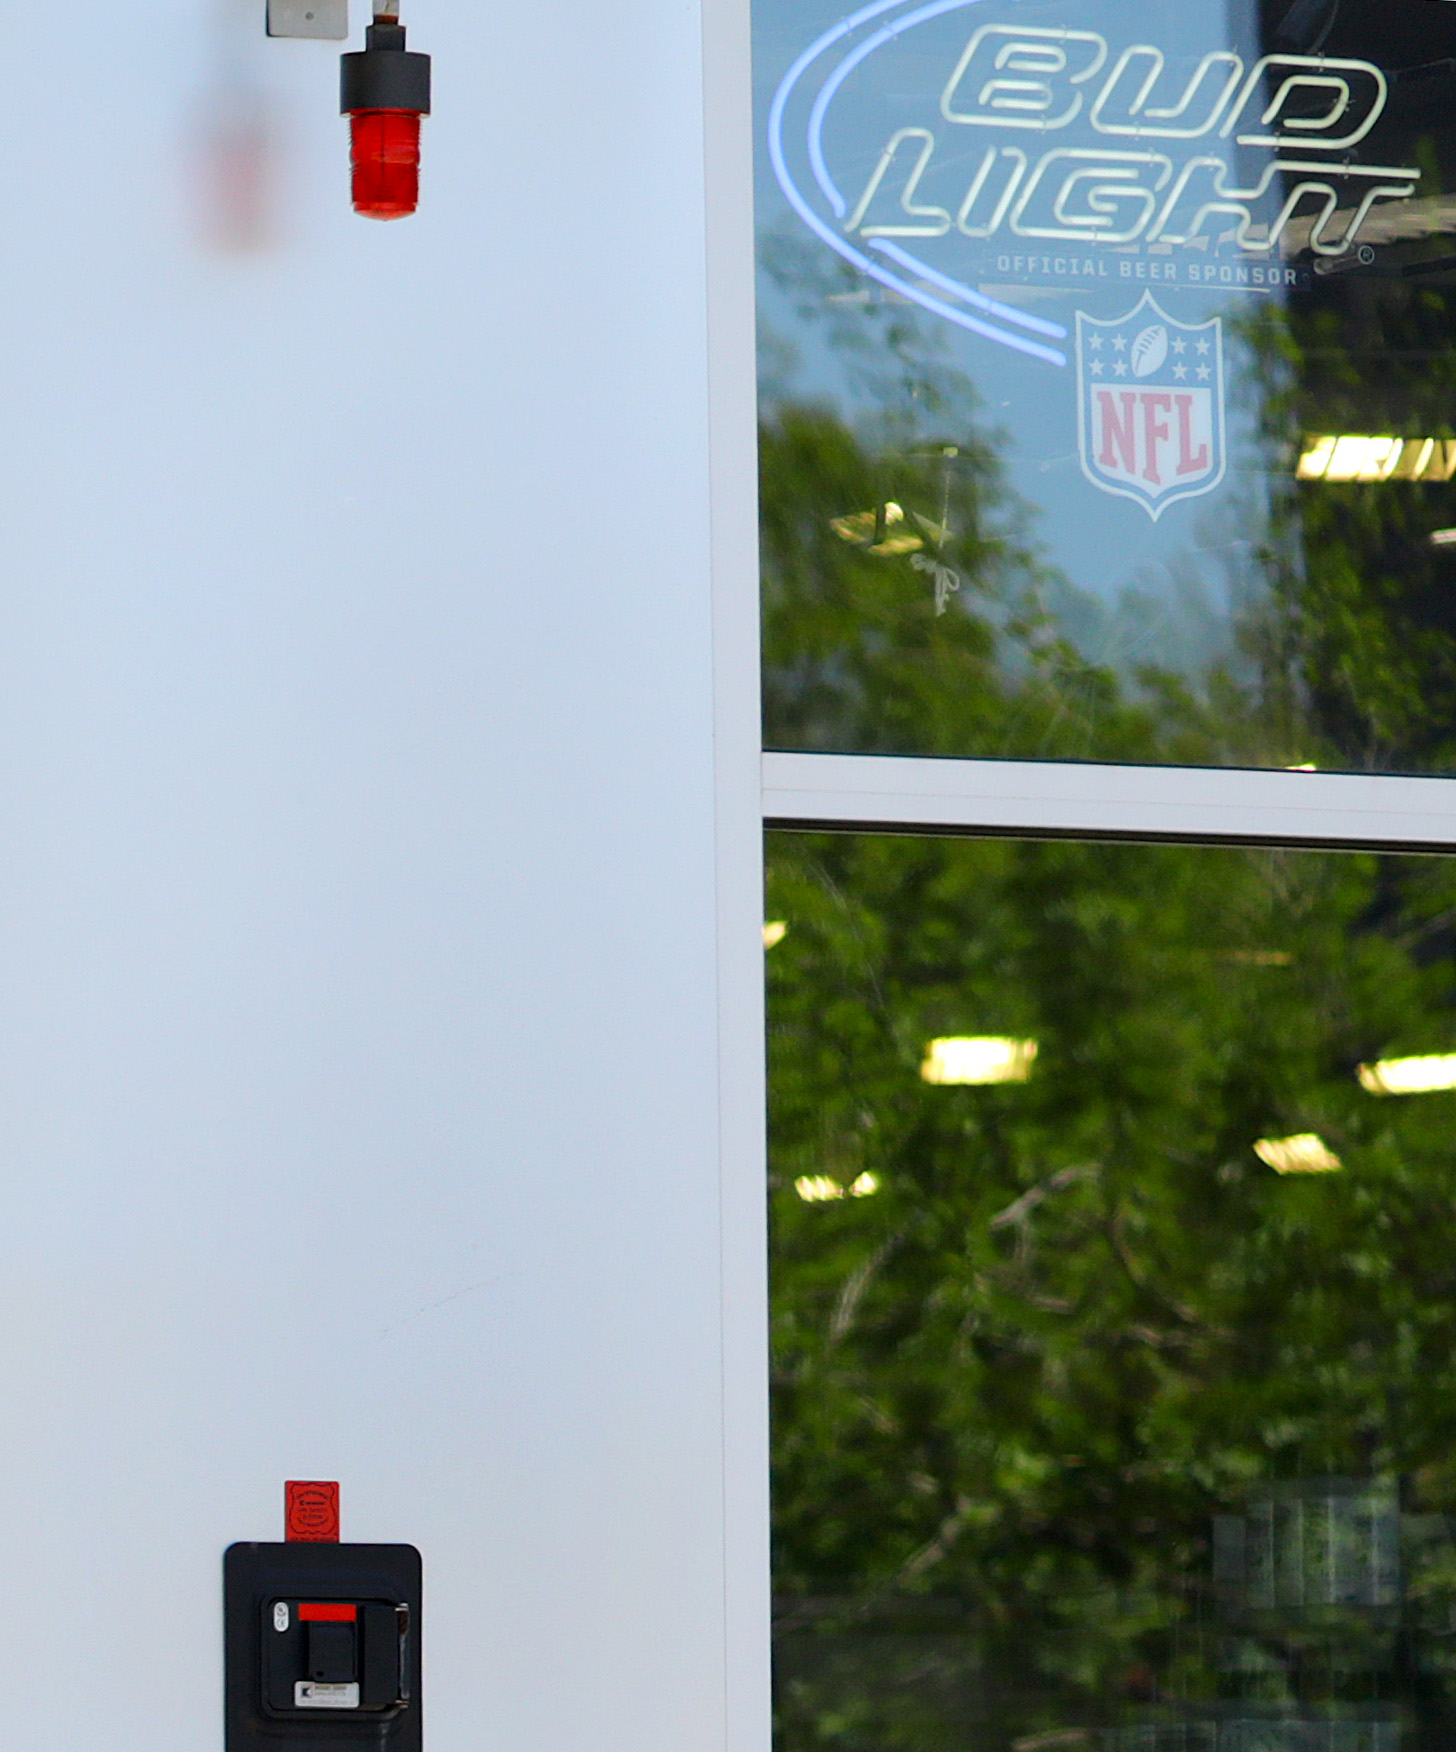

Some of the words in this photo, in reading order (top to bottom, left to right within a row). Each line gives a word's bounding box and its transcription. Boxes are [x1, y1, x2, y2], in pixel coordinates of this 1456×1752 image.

[940, 24, 1388, 150] BUD
[845, 128, 1421, 256] LIGHT
[997, 256, 1109, 277] OFFICIAL
[1119, 261, 1178, 280] BEER
[1189, 264, 1298, 285] SPONSOR
[1096, 389, 1208, 487] NFL
